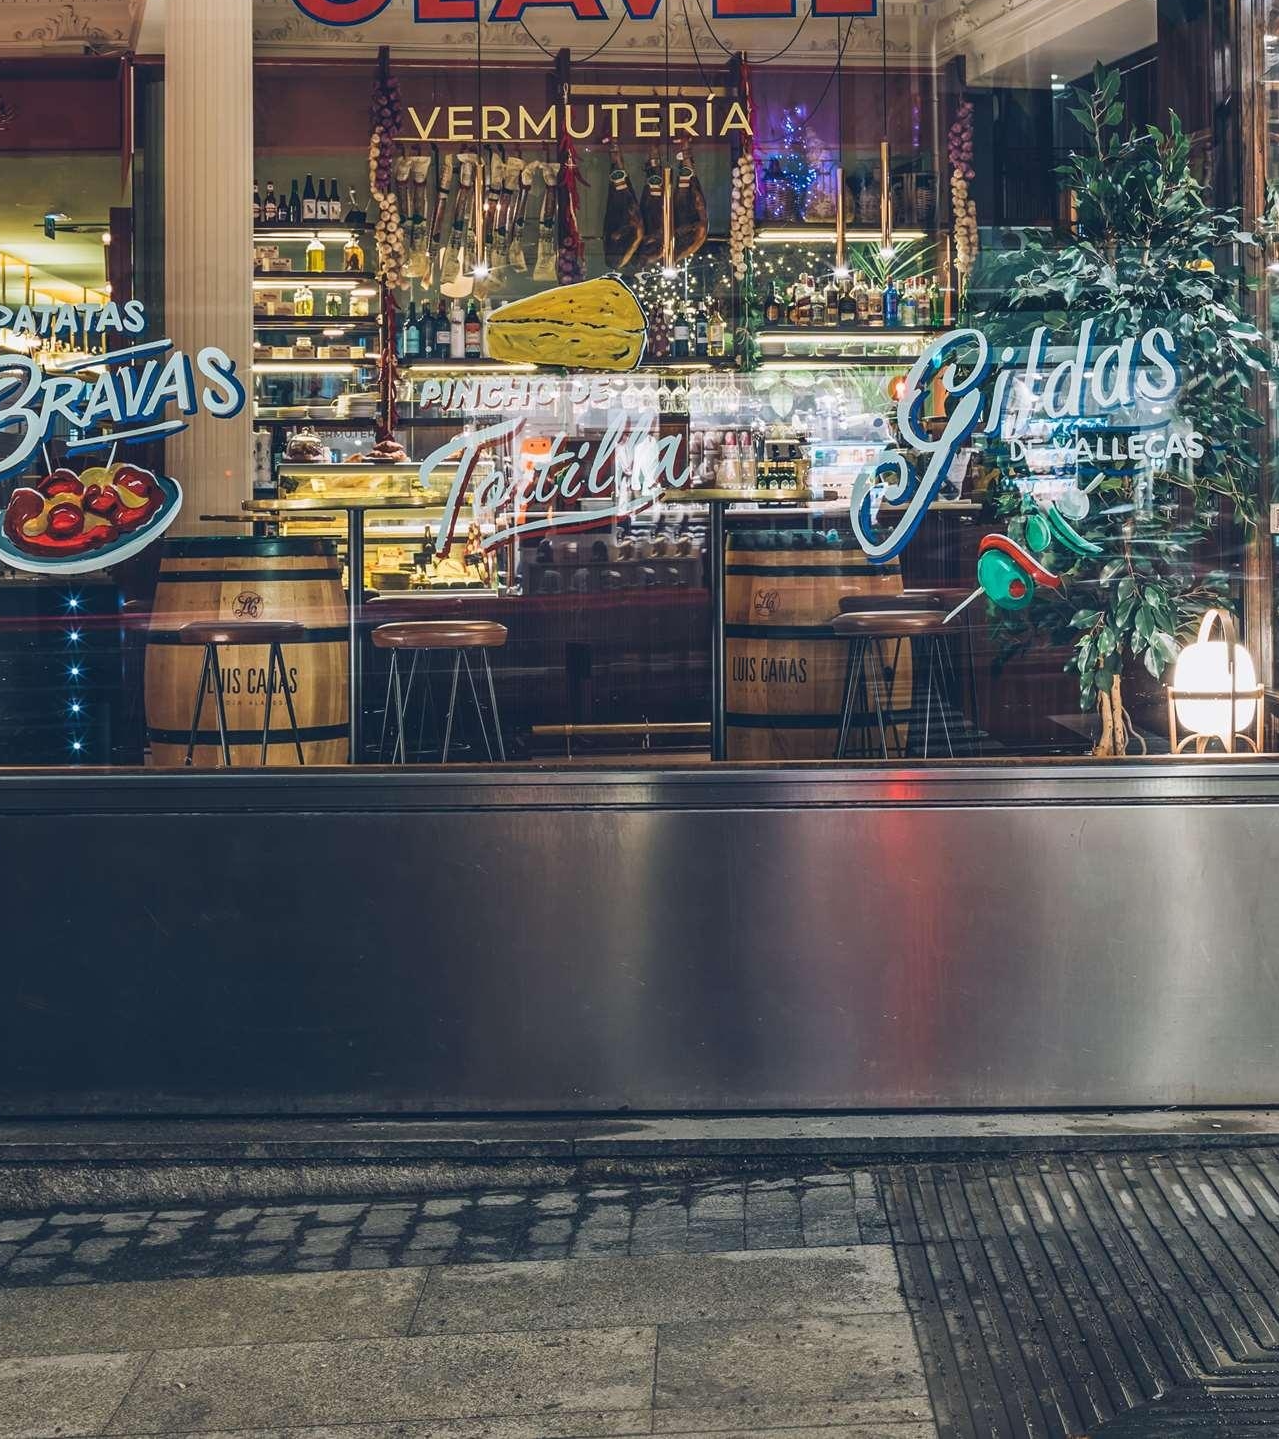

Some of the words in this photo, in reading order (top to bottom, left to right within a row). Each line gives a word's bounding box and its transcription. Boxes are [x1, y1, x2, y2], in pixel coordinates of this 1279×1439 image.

[408, 94, 754, 140] VERMUTERÍA
[421, 377, 556, 411] PINCHO
[569, 377, 612, 405] DE
[851, 319, 1178, 565] Gildas
[1053, 431, 1204, 463] VALLECAS
[419, 412, 692, 558] Tortilla
[733, 656, 756, 682] LUIS
[761, 656, 808, 683] CAÑAS
